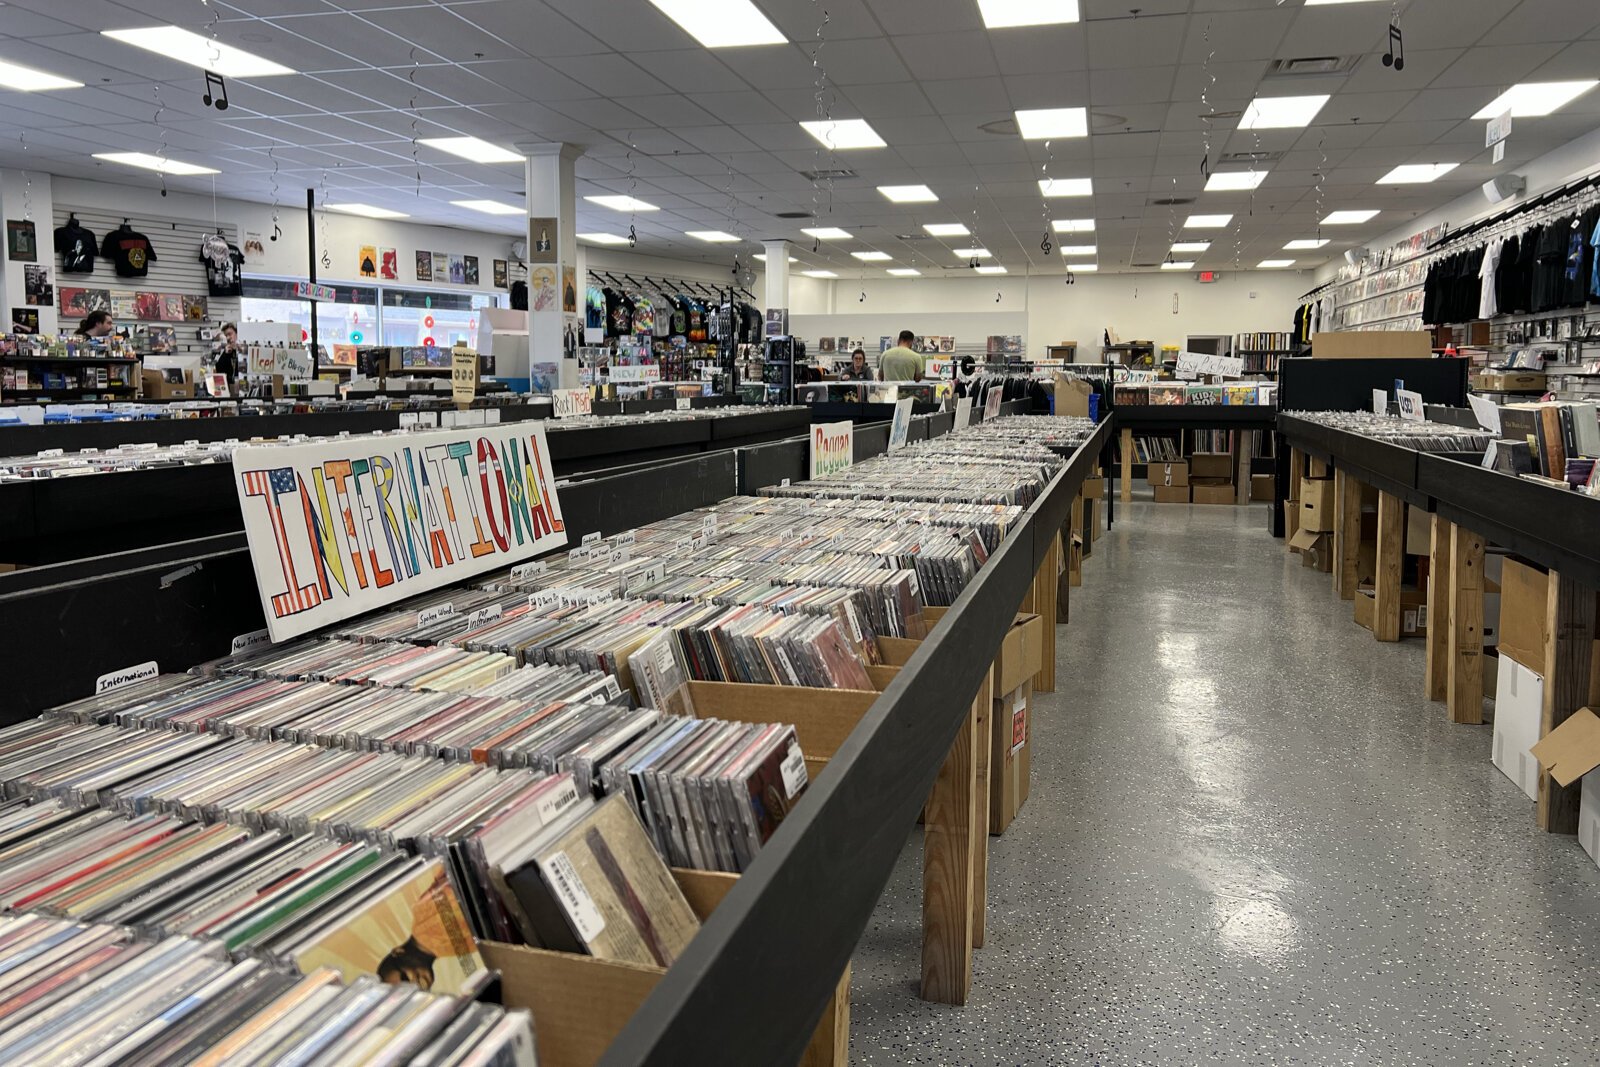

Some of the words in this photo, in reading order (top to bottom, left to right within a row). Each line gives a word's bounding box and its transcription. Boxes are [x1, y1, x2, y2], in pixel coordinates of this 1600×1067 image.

[251, 348, 276, 372] Used
[612, 369, 637, 379] NEW
[815, 427, 850, 475] Reggae
[241, 436, 565, 618] INTERNATIONAL
[419, 613, 437, 625] Spoken
[437, 605, 453, 616] Word
[233, 640, 246, 651] New
[100, 667, 157, 692] International
